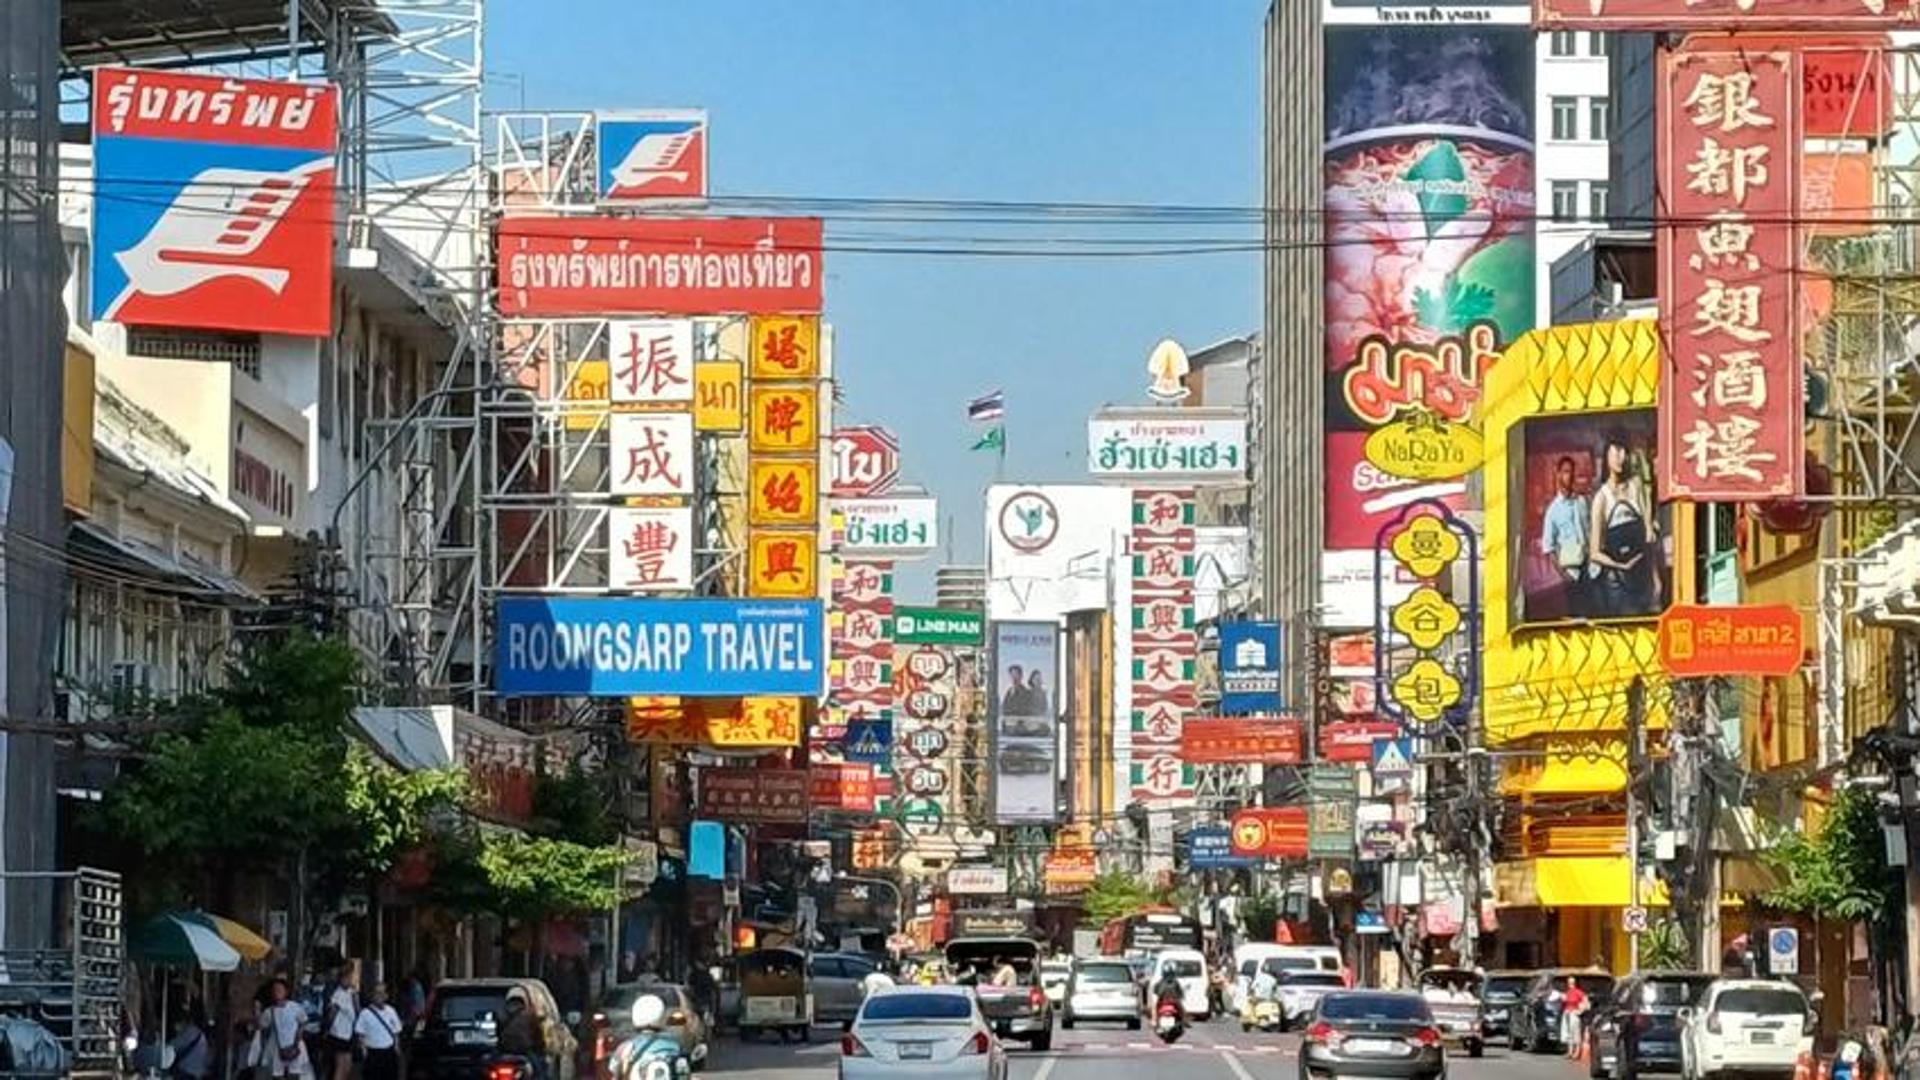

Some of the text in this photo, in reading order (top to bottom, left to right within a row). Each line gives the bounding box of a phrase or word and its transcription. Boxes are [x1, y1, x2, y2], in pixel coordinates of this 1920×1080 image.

[107, 75, 321, 133] รุ่งทรัพย์
[510, 224, 812, 308] รุ่งทรัพย์การท่องเที่ยว
[1681, 71, 1774, 482] 銀都魚翅酒樓
[615, 331, 689, 586] 振成豐
[1384, 440, 1464, 463] NaRaYa
[508, 622, 813, 672] ROONGSARP TRAVEL
[948, 620, 980, 634] MAN
[1147, 496, 1179, 790] 和成興大金行
